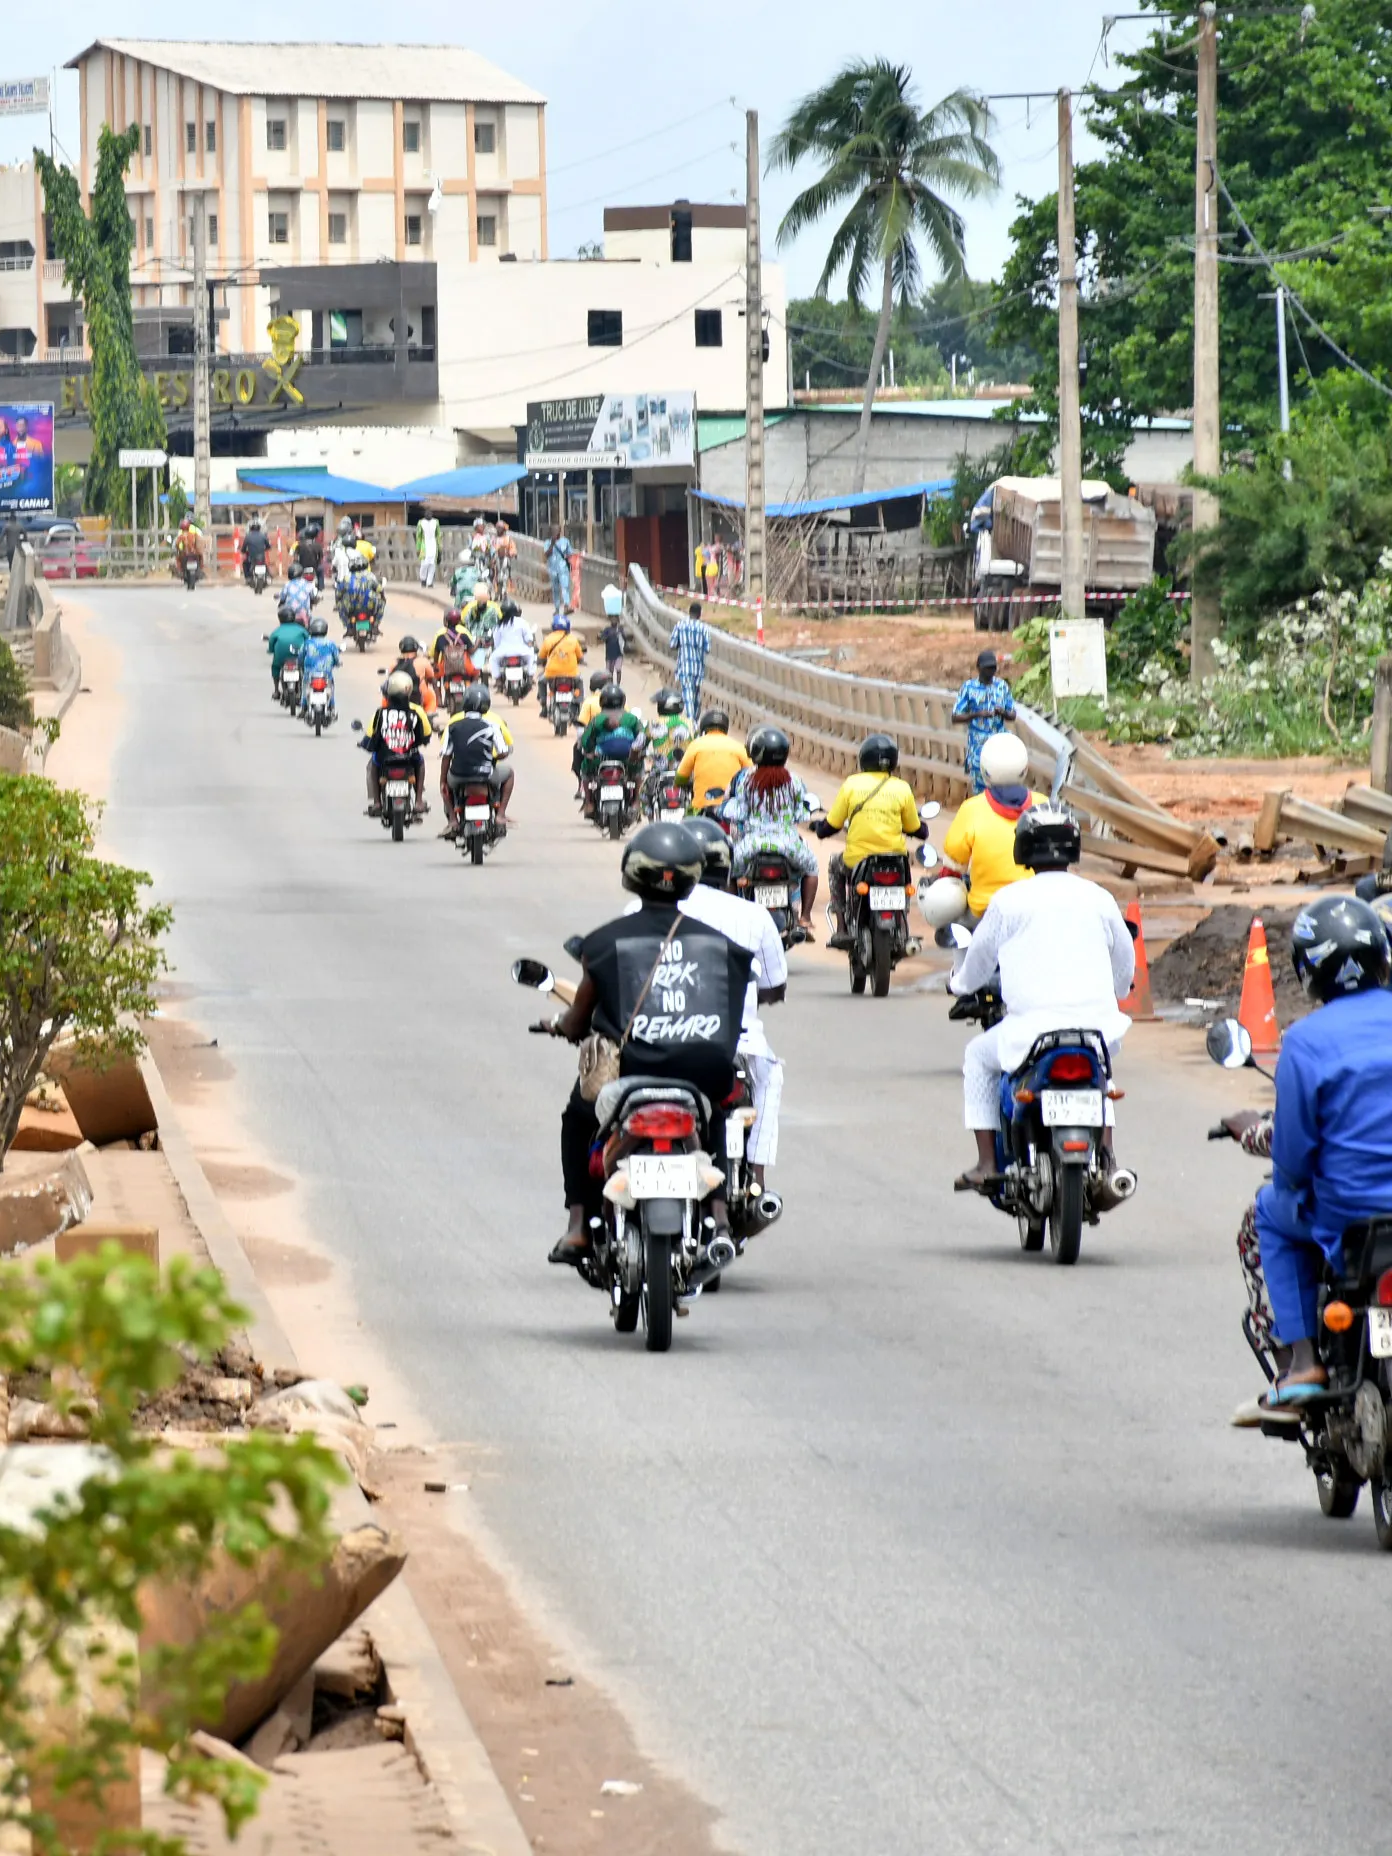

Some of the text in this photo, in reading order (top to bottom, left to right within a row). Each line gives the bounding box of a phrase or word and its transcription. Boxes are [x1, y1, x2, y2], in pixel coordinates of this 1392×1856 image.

[541, 397, 599, 422] TRUC DE LUXE
[660, 940, 683, 963] NO
[652, 961, 699, 988] RISK
[662, 990, 686, 1013] NO
[632, 1014, 721, 1045] REWARD
